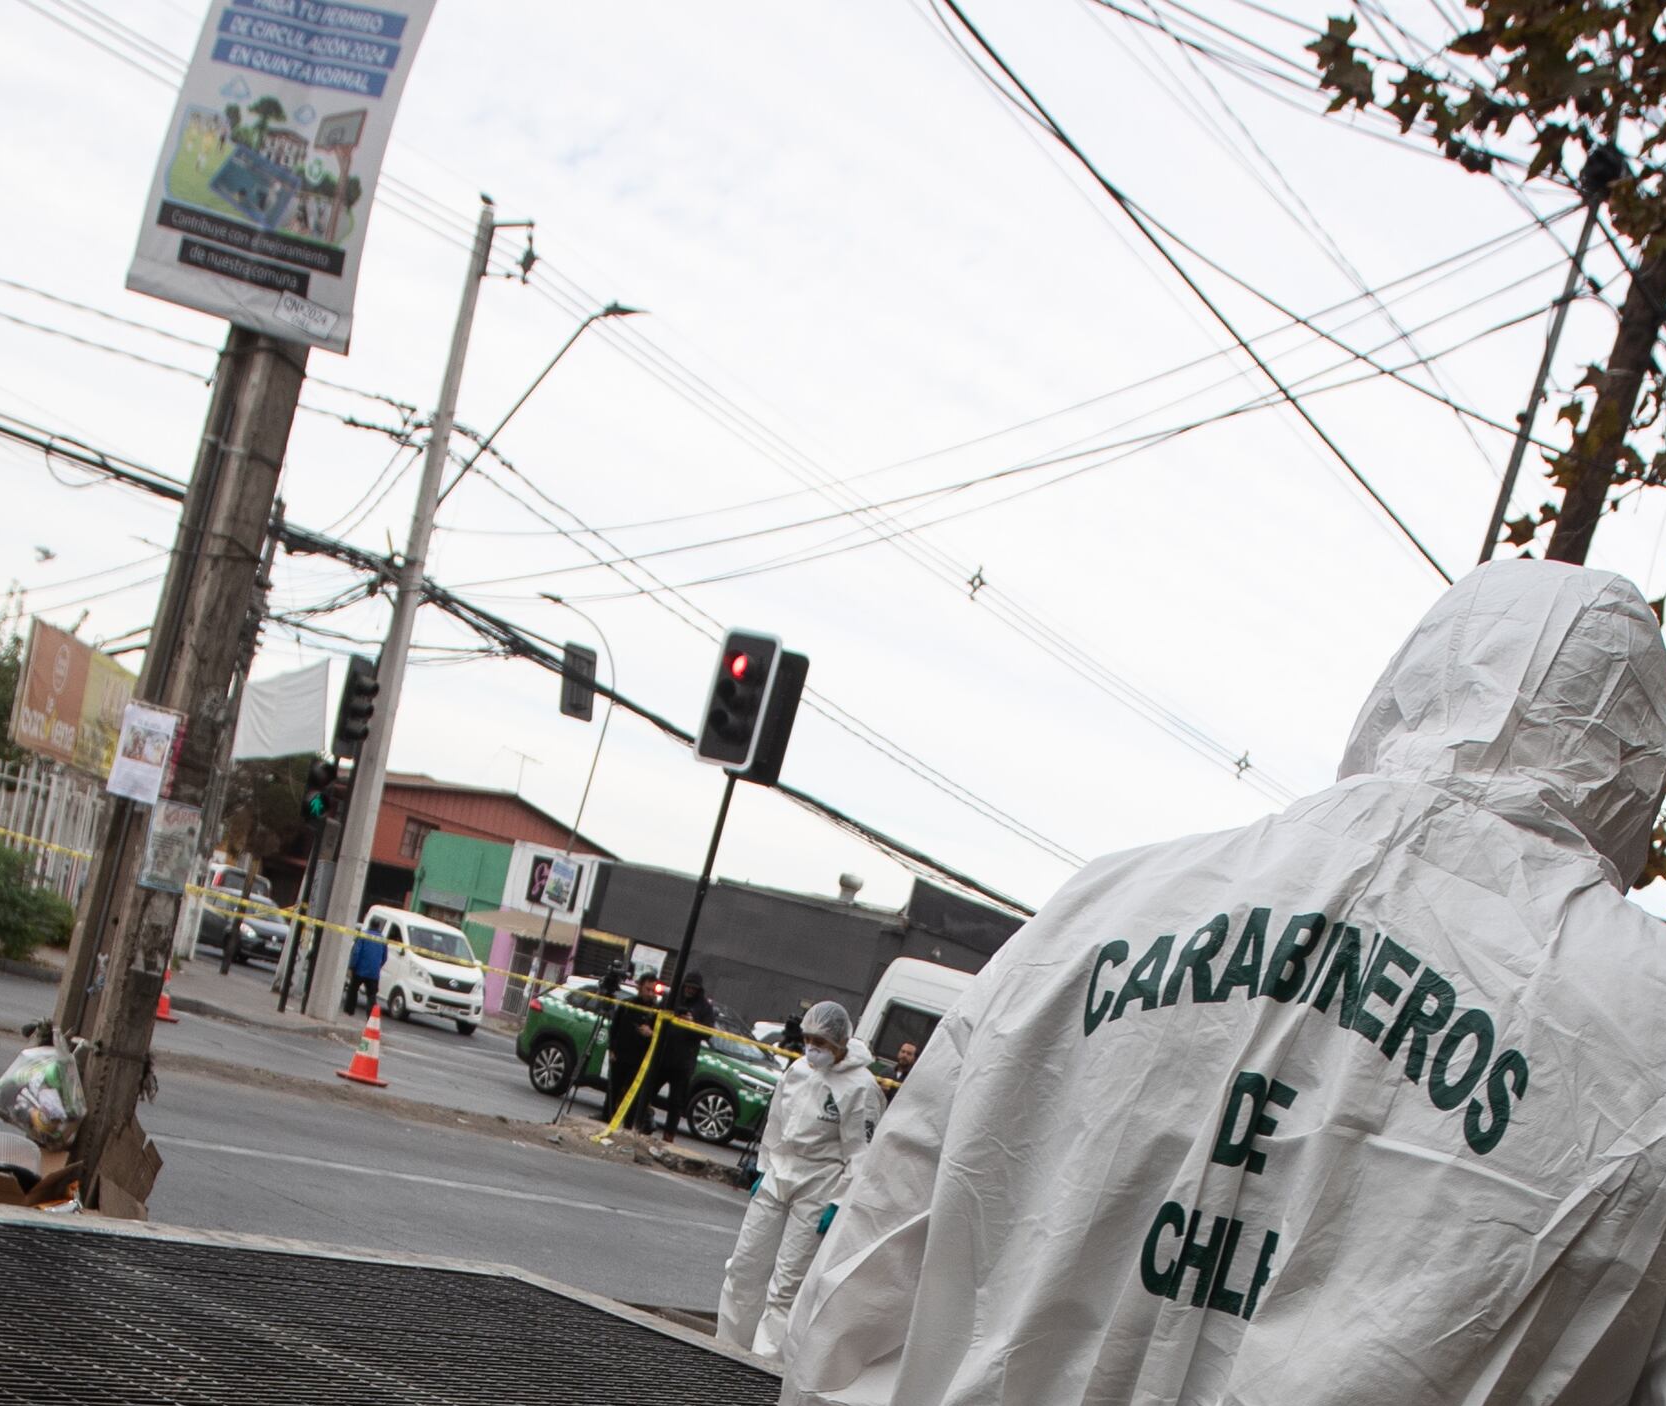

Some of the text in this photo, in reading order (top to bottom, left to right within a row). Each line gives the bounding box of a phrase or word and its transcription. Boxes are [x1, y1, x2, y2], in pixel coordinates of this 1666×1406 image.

[229, 15, 251, 35] DE
[229, 45, 369, 92] EN QUINTA NORMAL
[171, 209, 227, 238] Contribuye
[228, 227, 248, 245] con
[189, 245, 297, 289] de nuestra comuna
[1083, 907, 1529, 1155] CARABINEROS
[1210, 1071, 1299, 1175] DE
